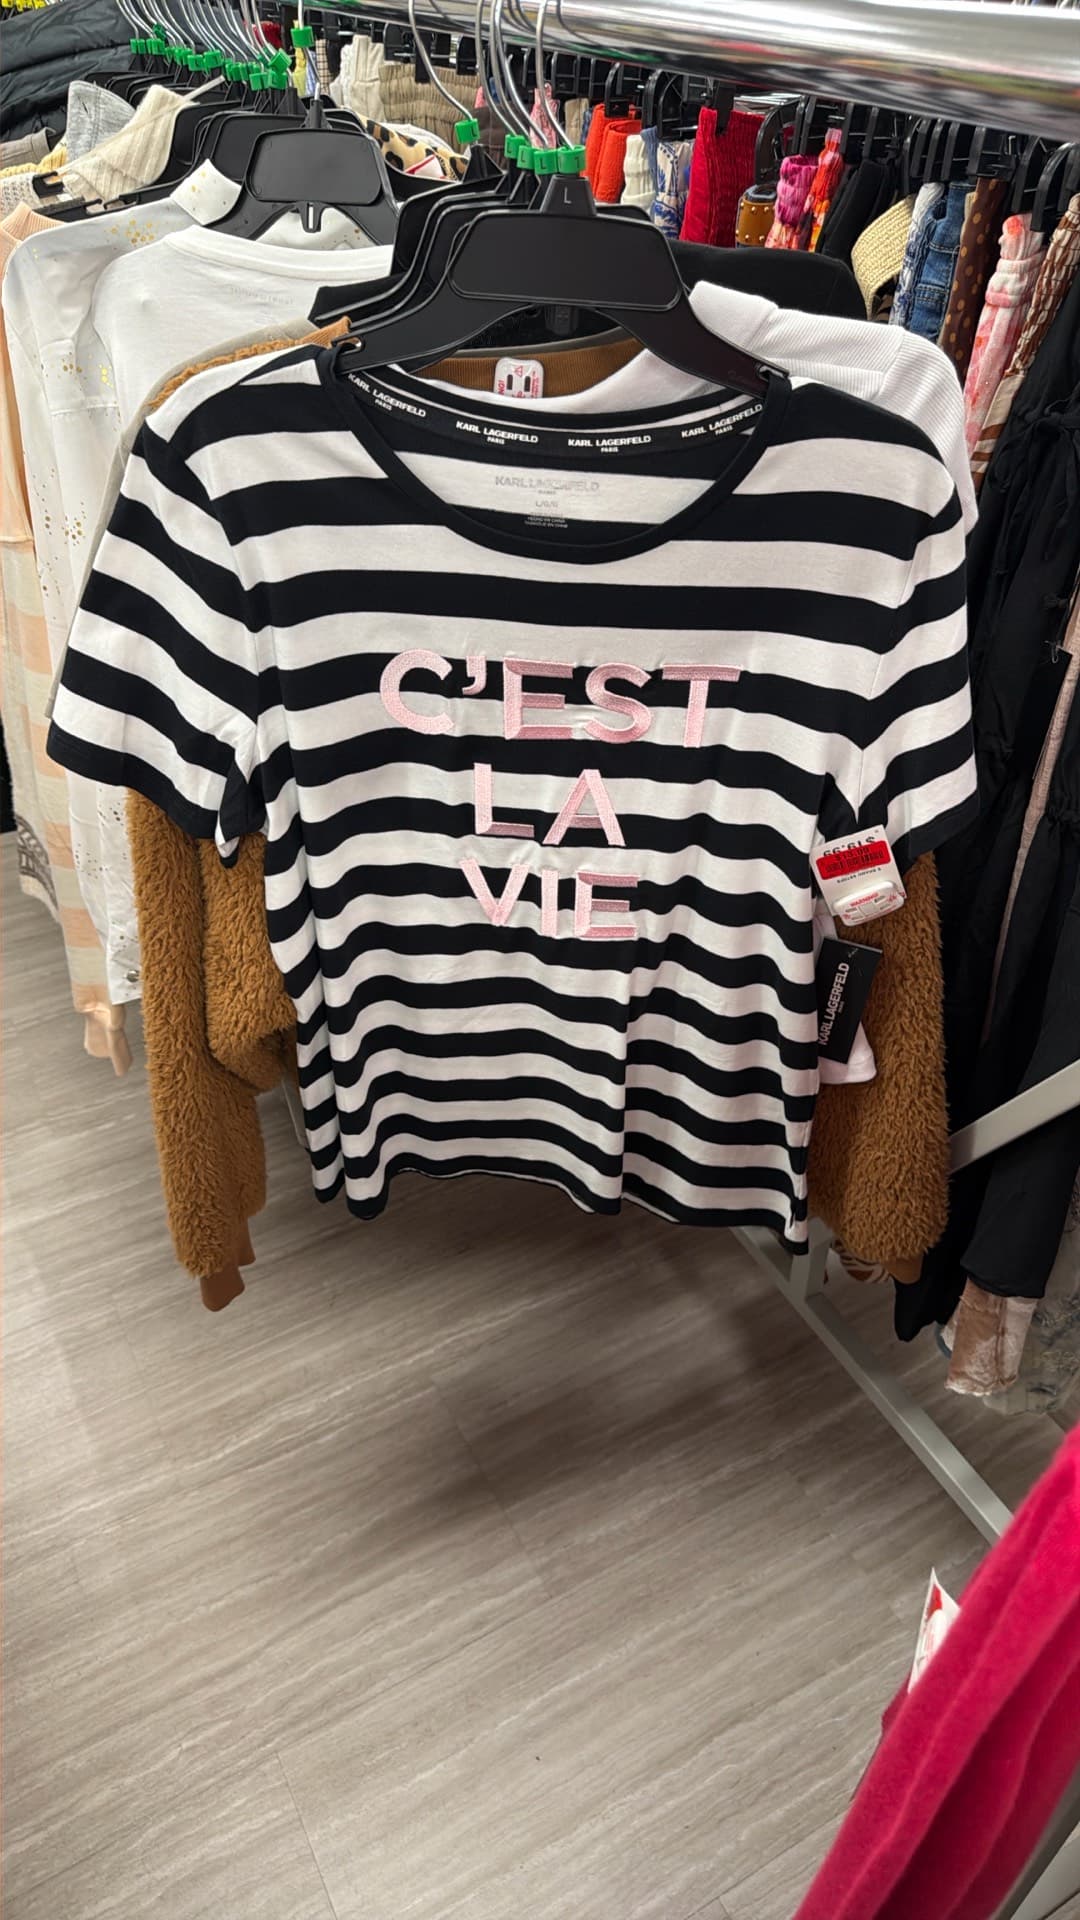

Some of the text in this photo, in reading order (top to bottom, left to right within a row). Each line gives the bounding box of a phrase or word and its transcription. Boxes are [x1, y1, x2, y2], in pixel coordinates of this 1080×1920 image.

[471, 128, 477, 138] L
[506, 141, 512, 154] L
[521, 150, 526, 163] L
[541, 157, 547, 170] L
[564, 186, 572, 204] L
[347, 373, 427, 418] KARL LAGERFELD
[681, 403, 764, 439] KARL LAGERFELD
[714, 424, 734, 436] PARIS
[455, 420, 539, 444] KARL LAGERFELD
[486, 436, 505, 445] PARIS
[567, 435, 652, 448] KARL LAGERFELD
[379, 648, 742, 748] C'EST
[473, 762, 626, 846] LA
[459, 858, 640, 939] VIE
[818, 962, 850, 1046] KARL LAGERFELD
